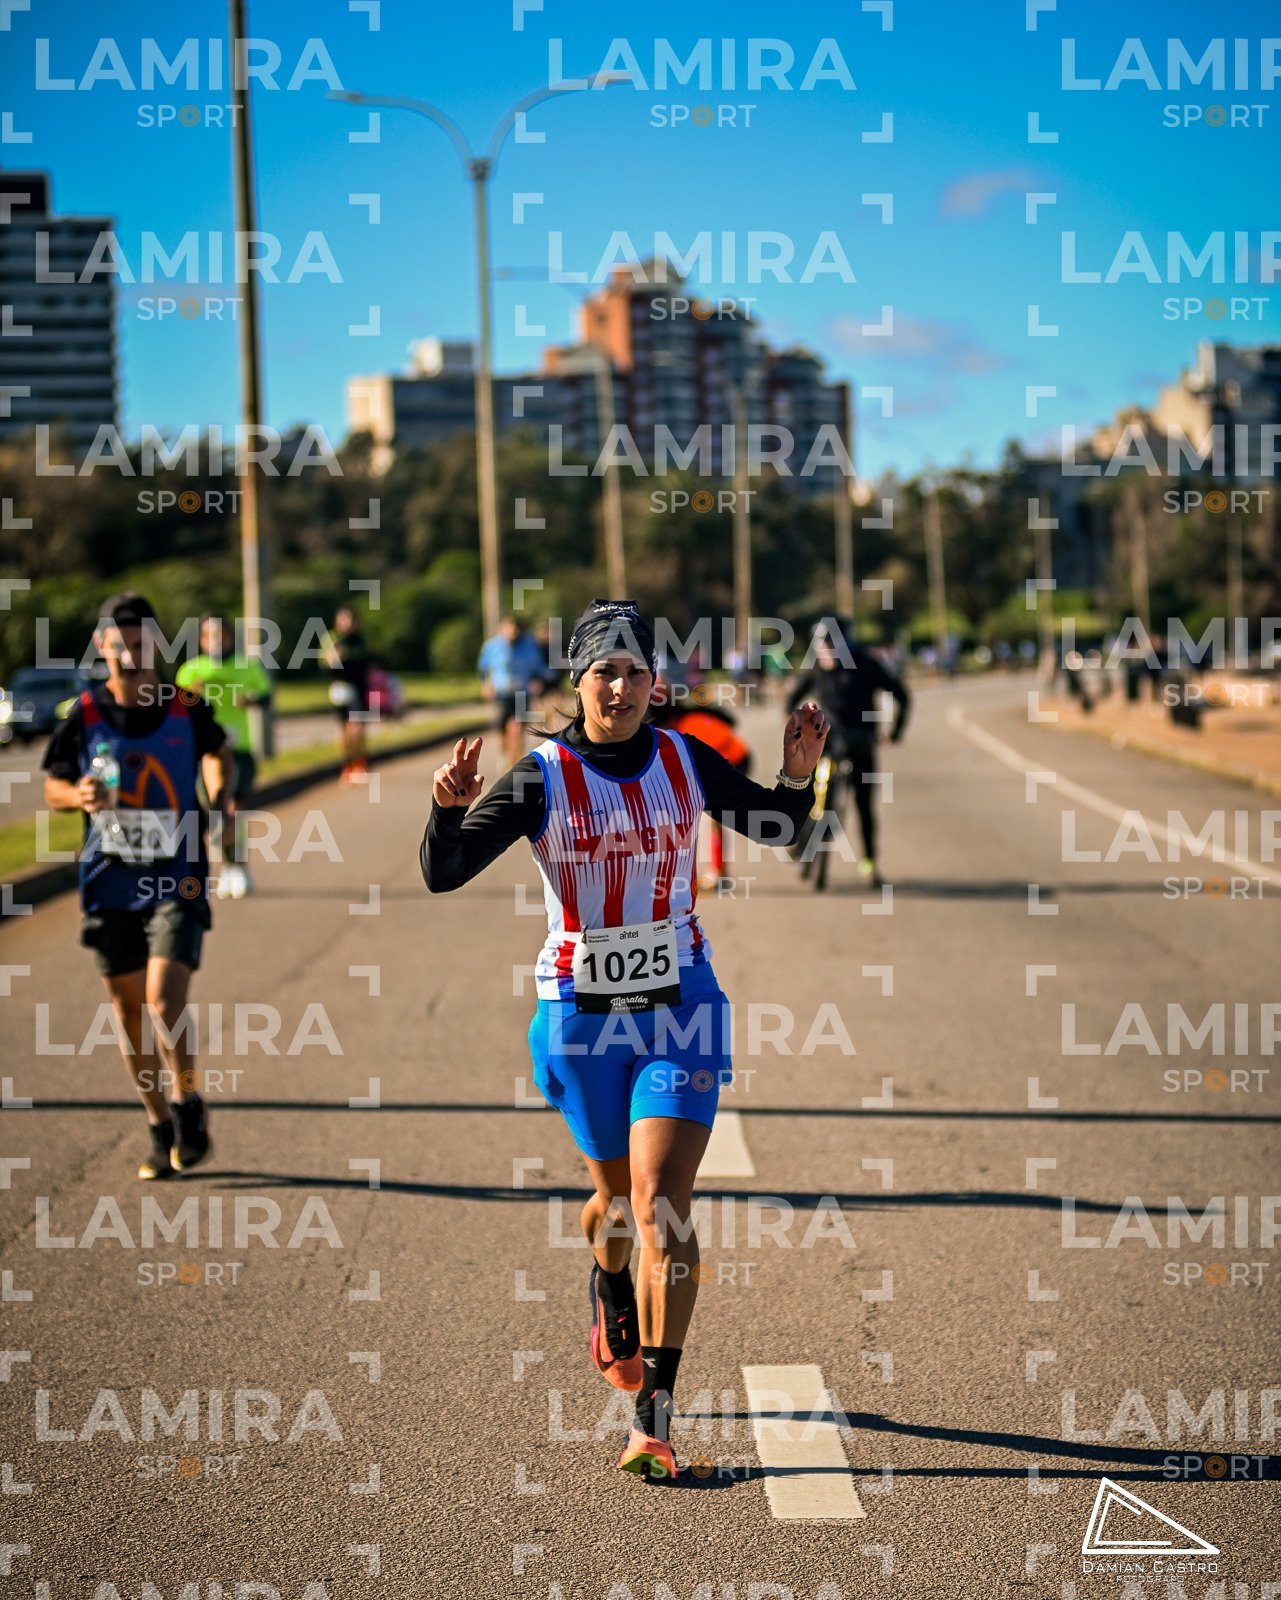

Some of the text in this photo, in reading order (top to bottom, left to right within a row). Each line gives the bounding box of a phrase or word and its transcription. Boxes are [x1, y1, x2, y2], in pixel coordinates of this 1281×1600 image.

[619, 930, 639, 940] antel
[582, 944, 671, 983] 1025
[610, 995, 649, 1007] Maratón
